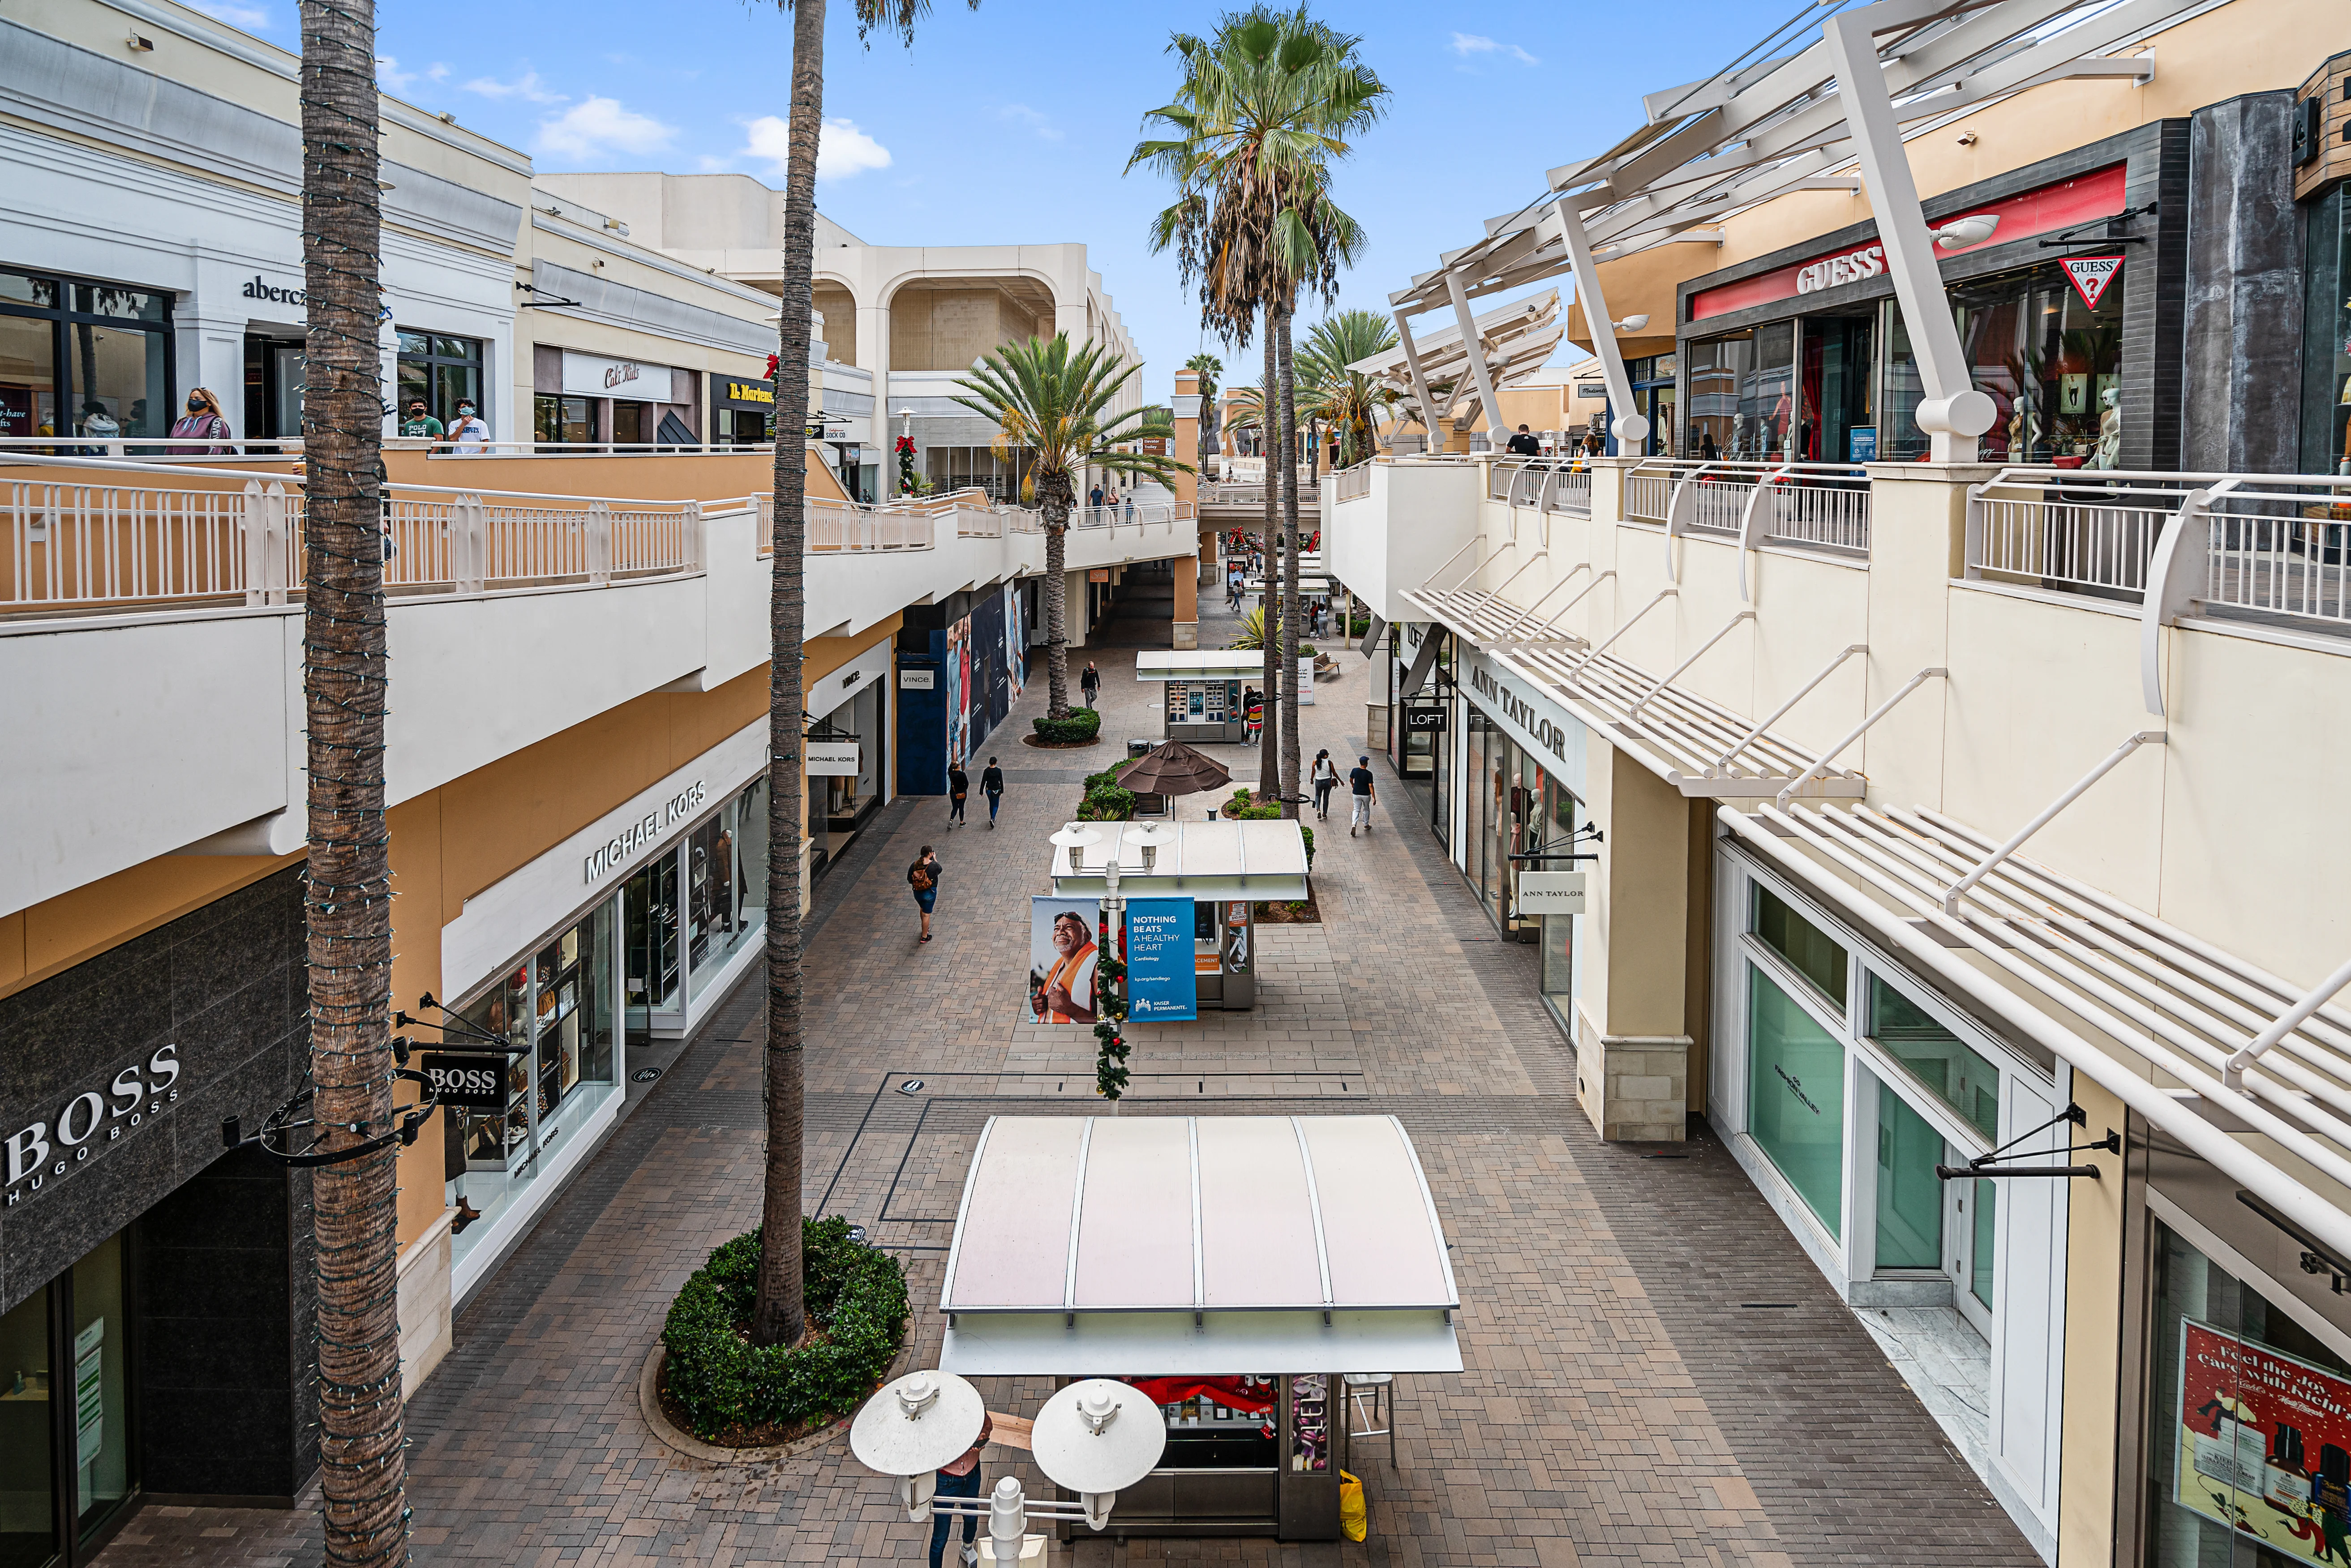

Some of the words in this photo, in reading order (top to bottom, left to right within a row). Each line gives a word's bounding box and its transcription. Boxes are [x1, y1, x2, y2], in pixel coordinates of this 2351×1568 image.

[1797, 247, 1883, 294] GUESS
[2070, 261, 2113, 273] GUESS
[604, 365, 622, 389] Cali
[622, 363, 640, 383] Kids
[1407, 623, 1424, 649] LOFT
[1410, 715, 1444, 724] LOFT
[1471, 666, 1498, 705] ANN
[1500, 686, 1566, 763] TAYLOR
[585, 812, 663, 885] MICHAEL
[666, 780, 706, 826] KORS
[429, 1068, 496, 1089] BOSS
[1774, 1064, 1798, 1092] FASHION
[1798, 1088, 1819, 1114] VALLEY
[5, 1044, 180, 1187] BOSS
[8, 1147, 88, 1206] HUGO
[110, 1089, 178, 1140] BOSS
[542, 1127, 559, 1148] KORS
[2197, 1353, 2241, 1374] Care
[2246, 1369, 2286, 1391] with
[2220, 1345, 2258, 1367] Feel
[2263, 1360, 2291, 1379] the
[2296, 1375, 2332, 1398] Joy.
